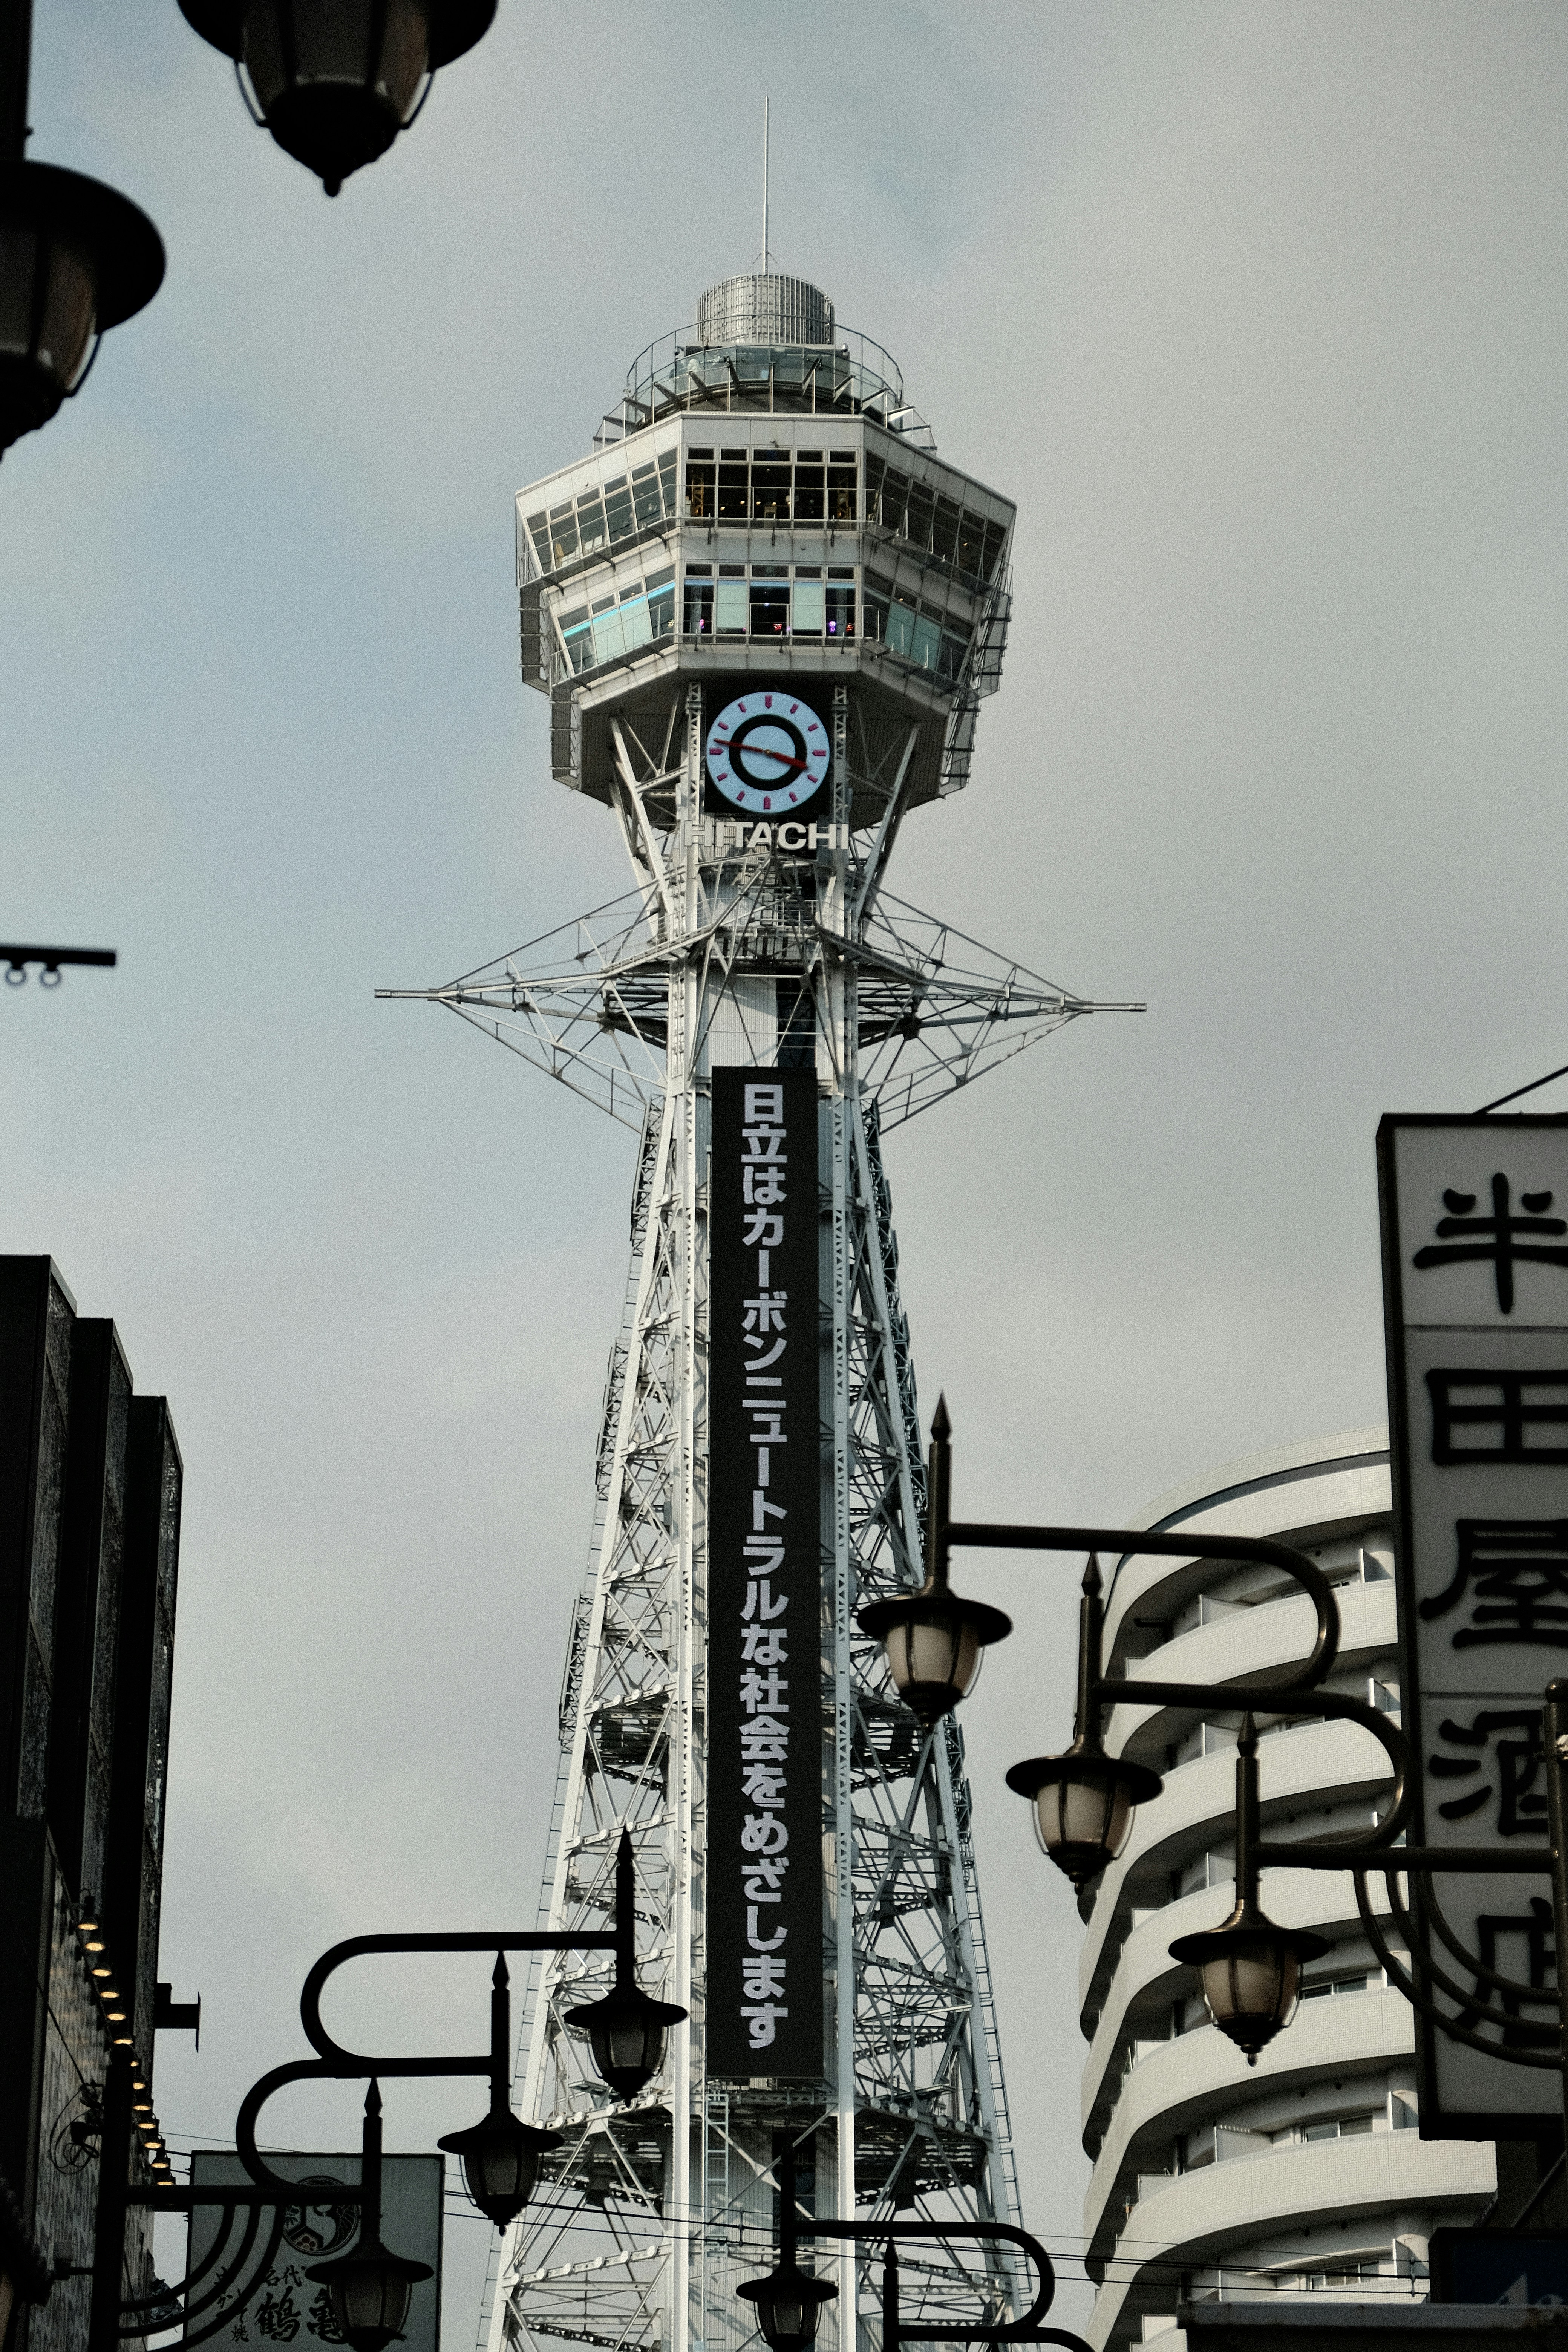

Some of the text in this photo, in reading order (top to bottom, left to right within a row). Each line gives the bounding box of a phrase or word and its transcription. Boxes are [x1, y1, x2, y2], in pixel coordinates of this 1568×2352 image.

[684, 820, 849, 850] HITACHI
[739, 1084, 790, 2048] 日立はカーボンニュートラルな社会をめざします
